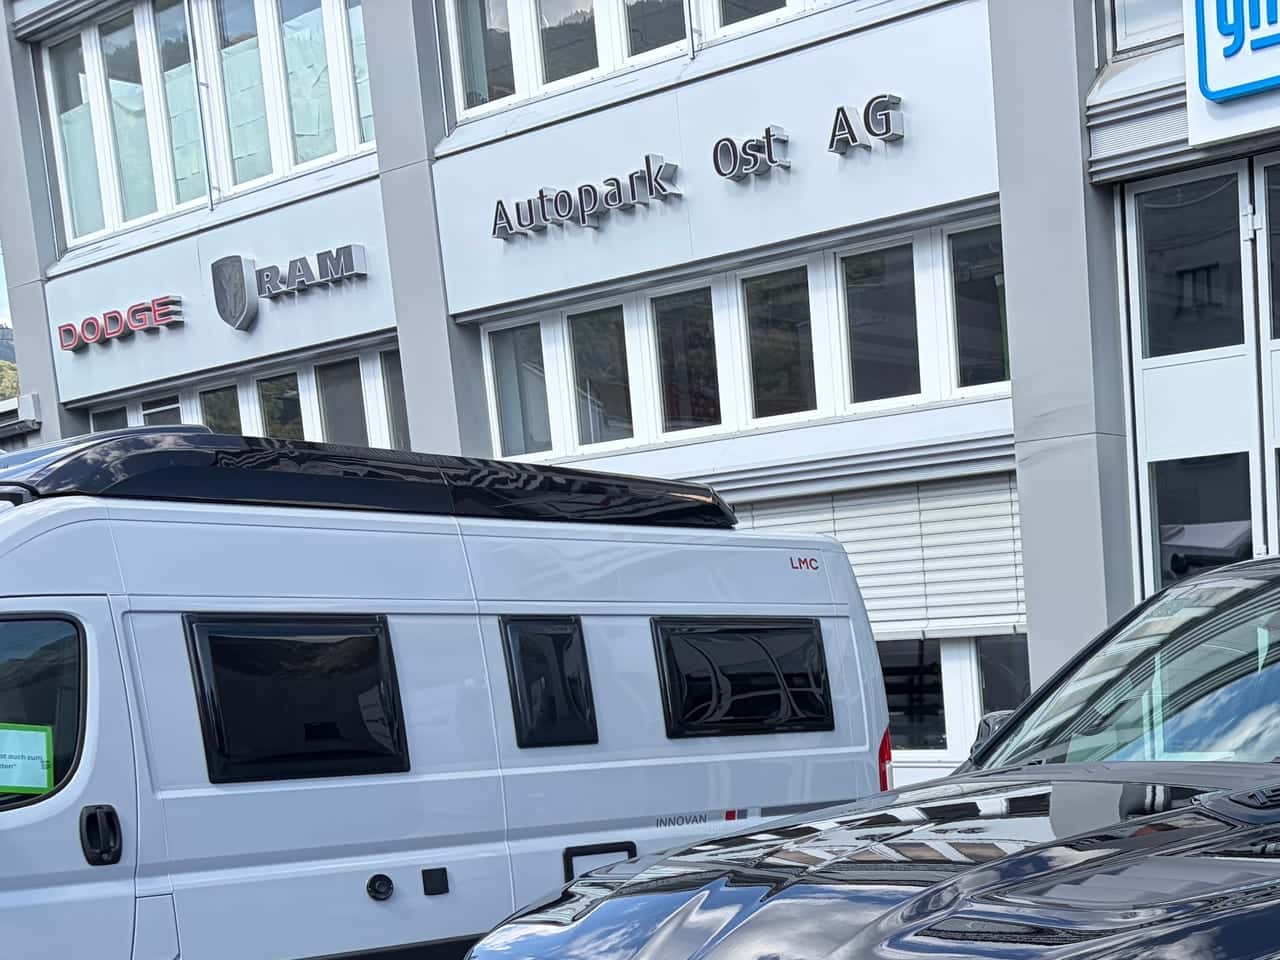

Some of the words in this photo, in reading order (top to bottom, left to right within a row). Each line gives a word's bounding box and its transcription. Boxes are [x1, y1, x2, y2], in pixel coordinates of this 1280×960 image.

[491, 153, 680, 240] Autopark
[712, 125, 790, 181] Ost
[828, 94, 904, 154] AG
[255, 244, 365, 298] RAM
[58, 295, 180, 351] DODGE
[789, 556, 820, 571] LMC
[655, 814, 708, 829] INNOVAN
